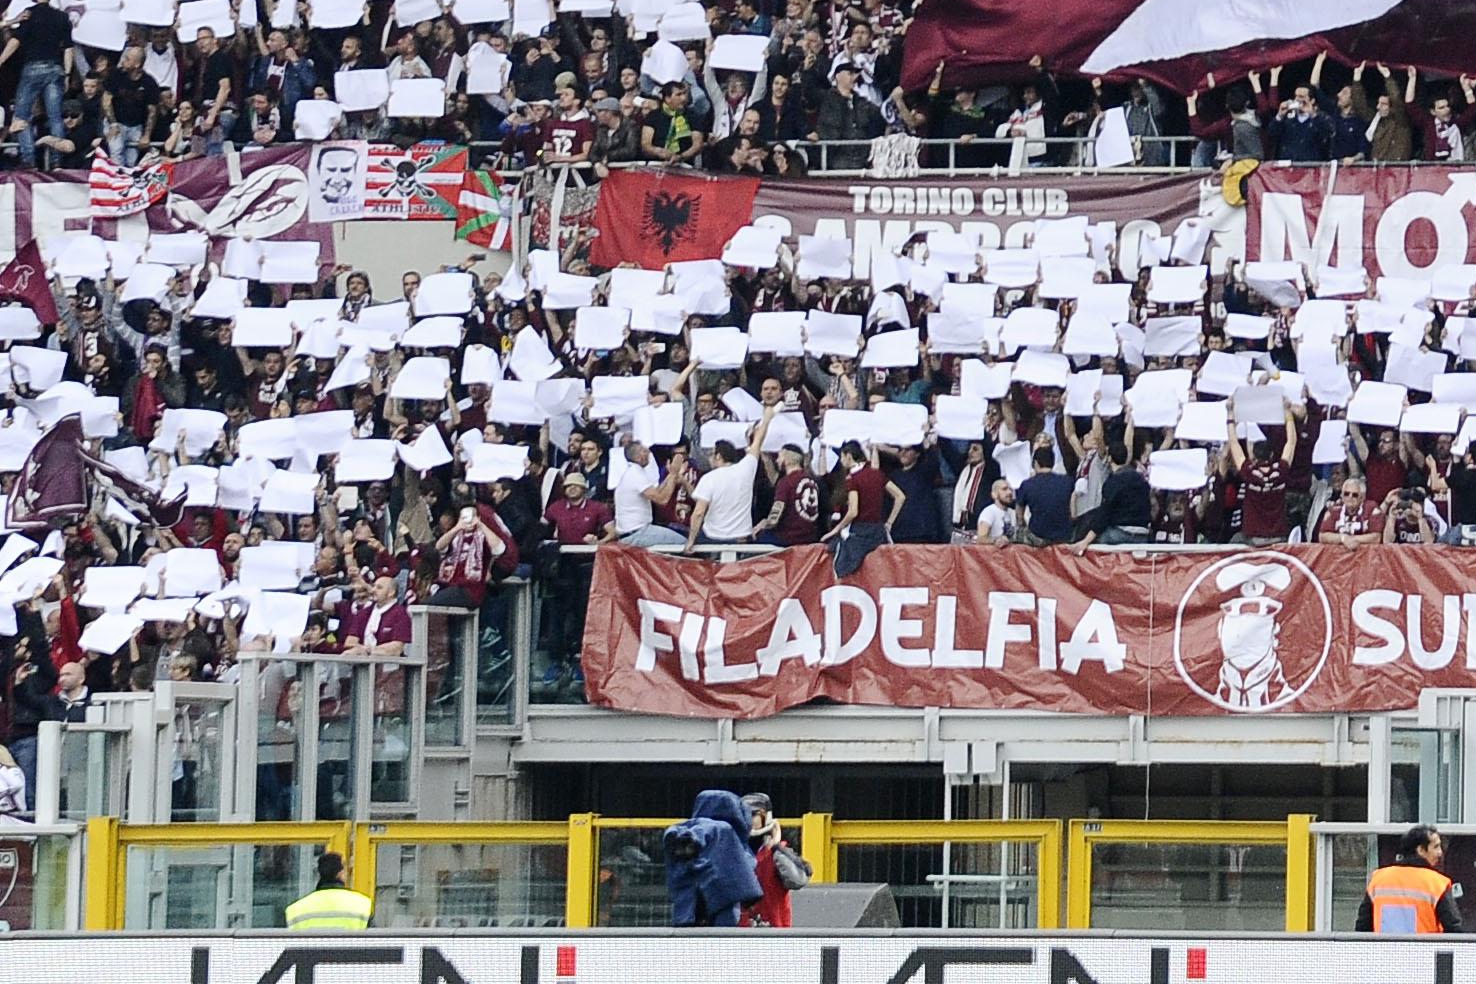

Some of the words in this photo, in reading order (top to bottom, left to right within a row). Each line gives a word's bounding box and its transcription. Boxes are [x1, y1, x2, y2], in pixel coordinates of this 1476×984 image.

[847, 185, 975, 215] TORINO
[982, 188, 1070, 216] CLUB
[635, 585, 1127, 685] FILADELFIA
